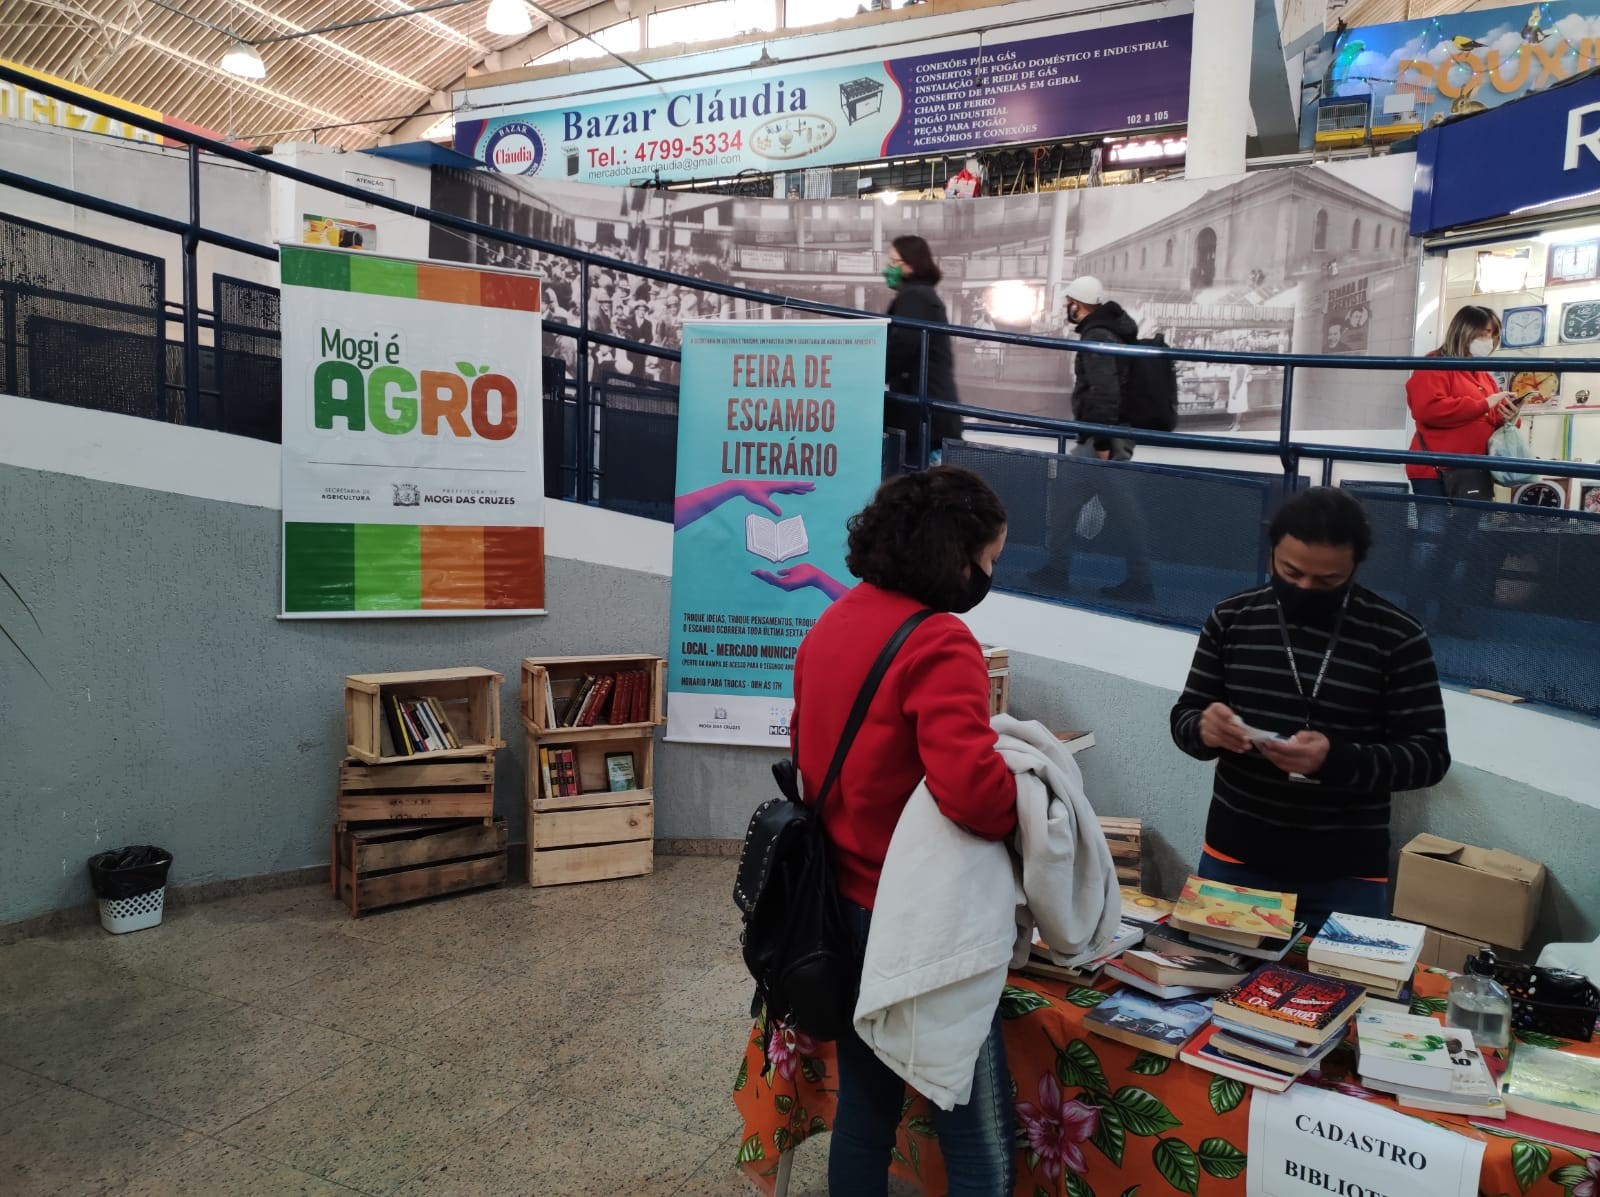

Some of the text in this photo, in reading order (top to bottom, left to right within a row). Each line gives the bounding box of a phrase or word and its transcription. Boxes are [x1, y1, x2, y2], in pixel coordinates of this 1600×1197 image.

[915, 40, 1169, 83] CONSERTOS DE FOGÃO DOMÉSTICO E INDUSTRIAL
[970, 55, 994, 66] PARA
[997, 50, 1017, 61] GÁS
[1396, 36, 1600, 105] ROUXI
[915, 79, 973, 94] INSTALAÇÃO
[992, 73, 1019, 81] REDE
[1021, 70, 1035, 79] DE
[1038, 67, 1058, 76] GÁS
[915, 75, 1081, 104] CONSERTO DE PANELAS EM GERAL
[562, 80, 808, 142] Bazar Cláudia
[914, 107, 1008, 125] FOGÃO INDUSTRIAL
[915, 98, 996, 115] CHAPA DE FERRO
[1127, 115, 1142, 125] 102
[1154, 111, 1169, 121] 105
[499, 124, 528, 137] BAZAR
[913, 131, 972, 146] ACESSÓRIOS
[975, 131, 981, 139] E
[914, 117, 1007, 136] PEÇAS PARA FOGÃO
[587, 128, 743, 168] Tel.: 4799-5334
[589, 154, 741, 179] mercadobazarclaudia@gmail.com
[321, 326, 400, 370] Mogi é
[732, 354, 832, 388] FEIRA DE
[314, 361, 518, 441] AGRO
[727, 397, 835, 433] ESCAMBO
[721, 436, 838, 477] LITERÁRIO
[321, 494, 371, 502] AGRICULTURA
[424, 495, 515, 505] MOGI DAS CRUZES
[684, 612, 705, 622] TROQUE
[728, 615, 750, 624] TROQUE
[689, 624, 715, 633] ESCAMBO
[747, 627, 761, 635] TODA
[681, 642, 708, 655] LOCAL
[717, 643, 758, 658] MERCADO
[761, 645, 798, 659] MUNICIP
[708, 678, 722, 688] PARA
[724, 679, 746, 688] TROCAS
[1295, 1114, 1427, 1171] CADASTRO
[1285, 1159, 1391, 1197] BIBLIOT
